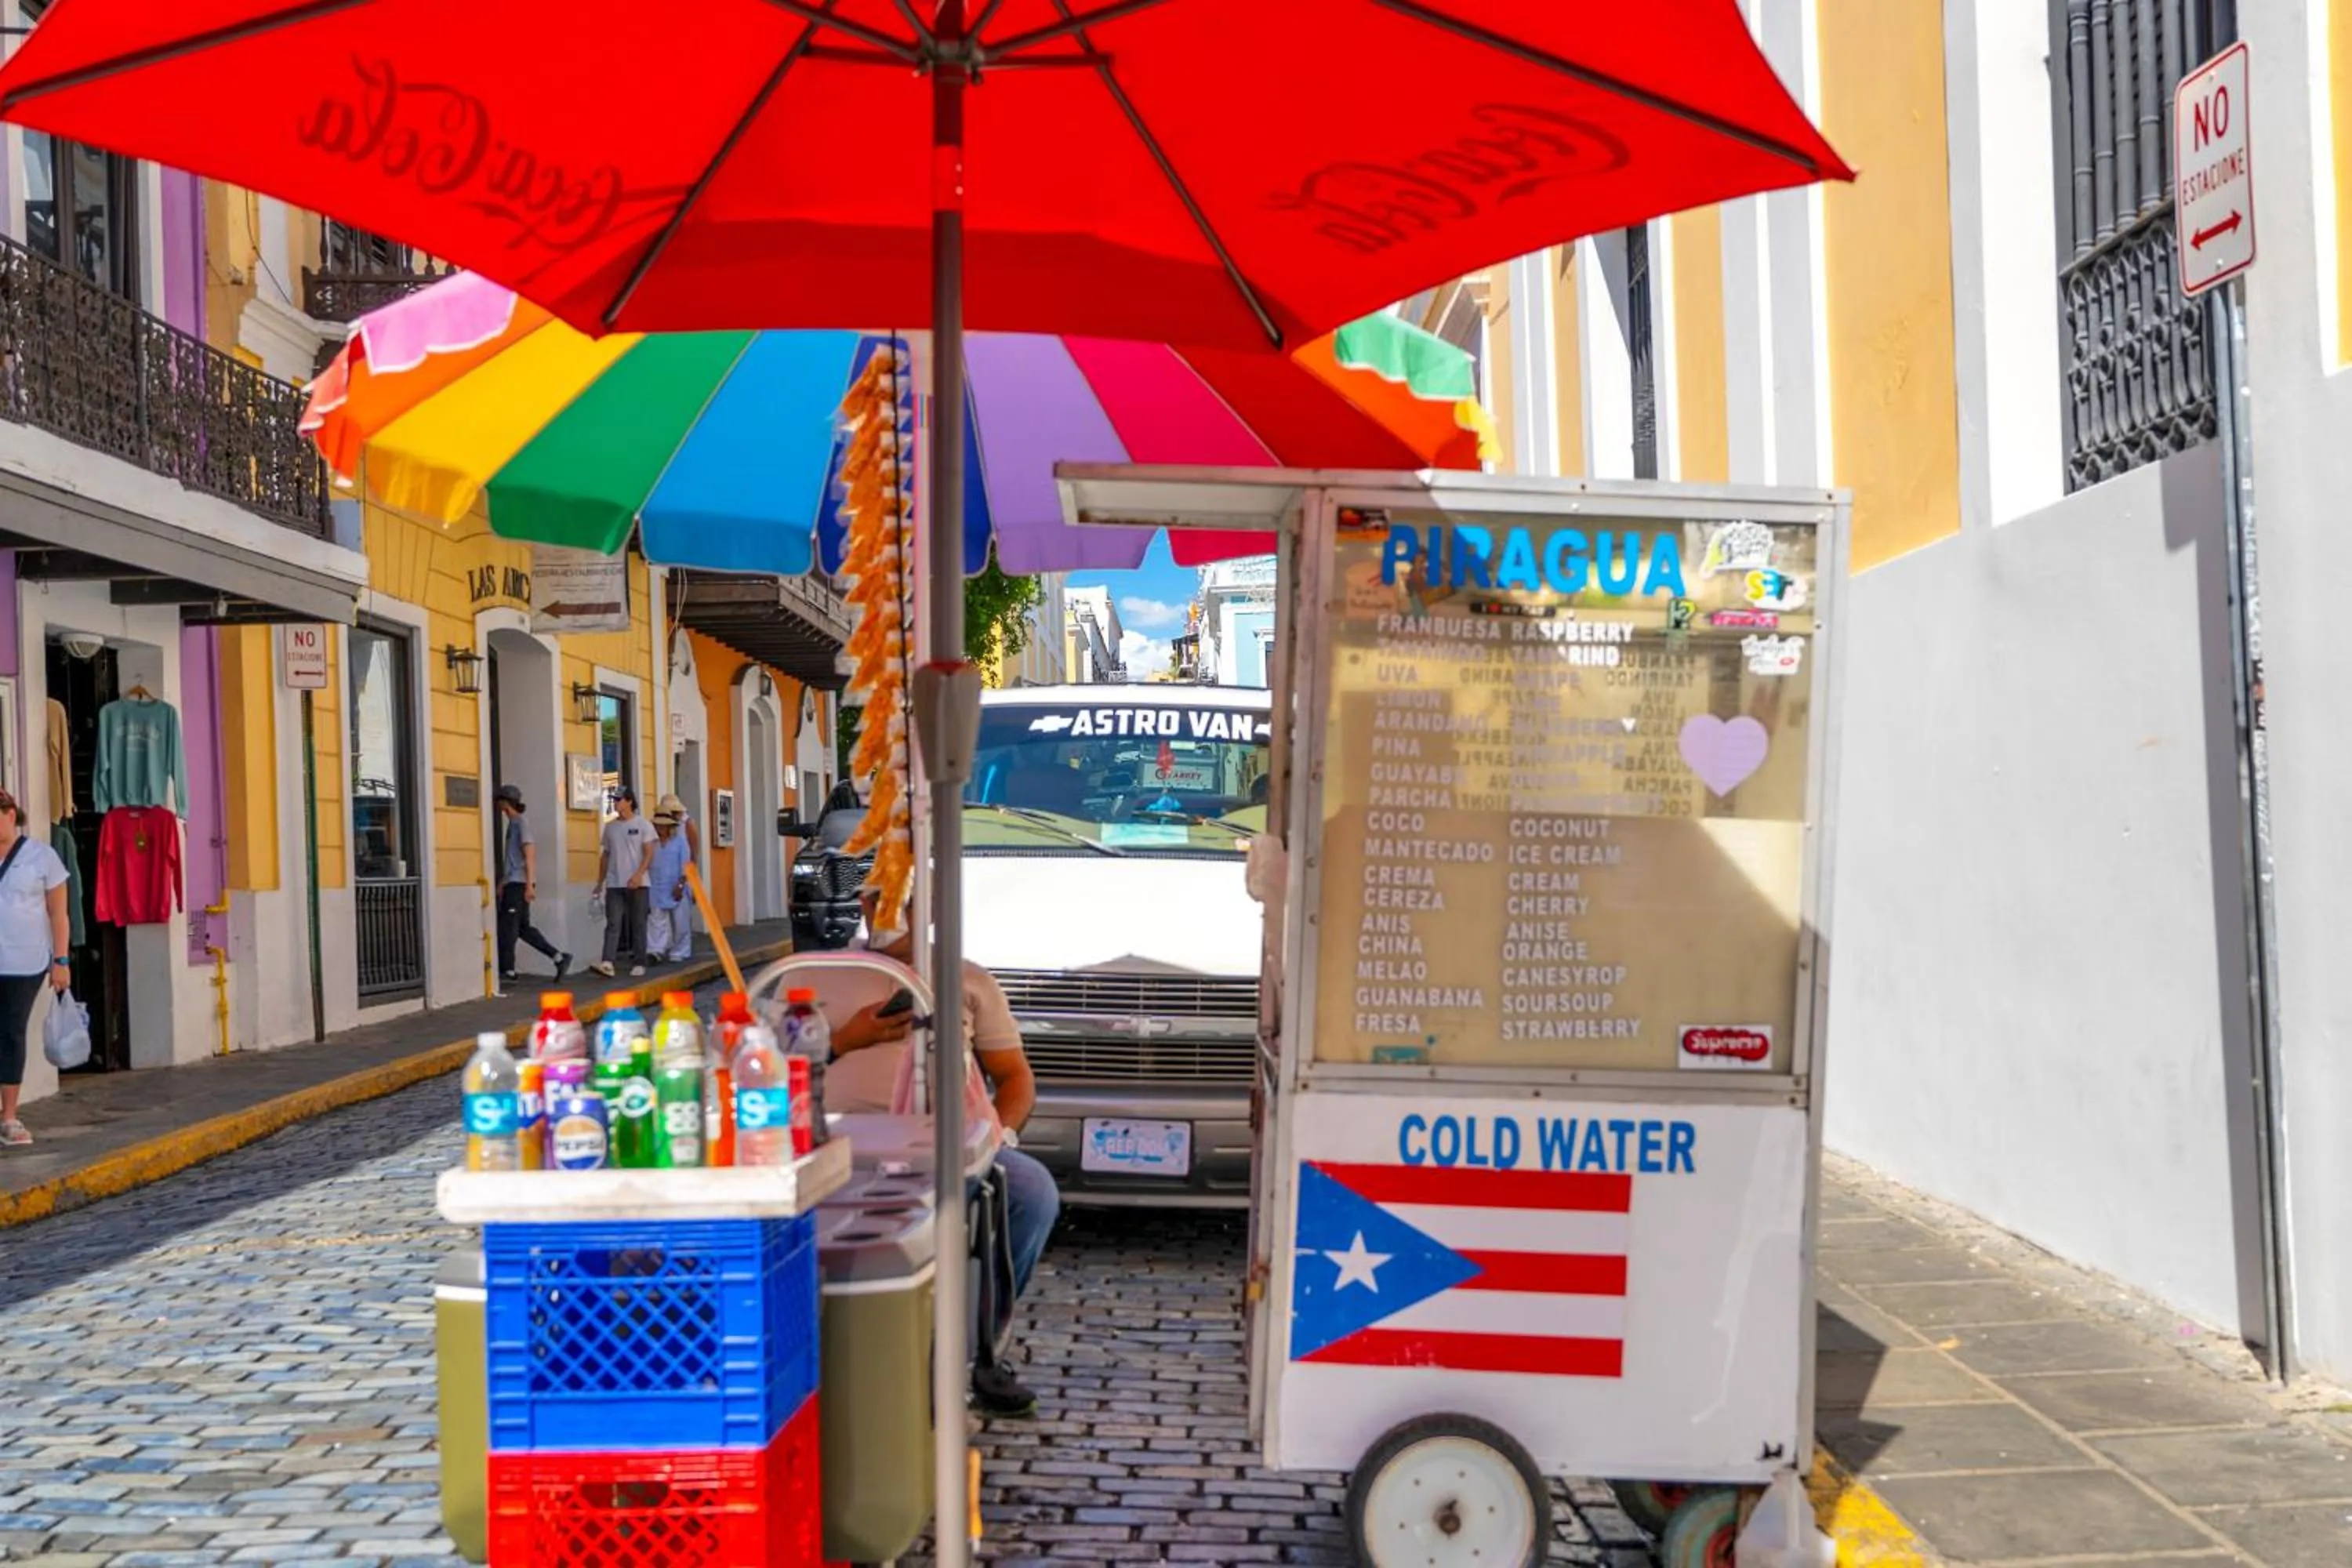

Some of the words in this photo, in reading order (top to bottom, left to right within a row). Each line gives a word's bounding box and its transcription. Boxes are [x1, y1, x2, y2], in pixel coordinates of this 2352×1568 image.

[2194, 85, 2229, 152] NO
[2183, 148, 2245, 205] ESTACIONE
[1381, 524, 1686, 597] PIRAGUA
[468, 564, 496, 602] LAS
[1377, 614, 1501, 640] FRANBUESA
[1512, 621, 1634, 643] RASPBERRY
[295, 631, 315, 648] NO
[1377, 663, 1417, 682] UVA
[1071, 709, 1180, 736] ASTRO
[1189, 711, 1252, 740] VAN
[1369, 786, 1451, 808] PARCHA
[1367, 812, 1425, 833] COCO
[1510, 818, 1611, 838] COCONUT
[1365, 839, 1494, 862] MANTECADO
[1508, 846, 1541, 864] ICE
[1549, 845, 1621, 865] CREAM
[1364, 866, 1435, 886] CREMA
[1508, 873, 1580, 892] CREAM
[1364, 888, 1444, 909] CEREZA
[1507, 897, 1589, 916] CHERRY
[1362, 913, 1410, 934] ANIS
[1507, 922, 1569, 941] ANISE
[1359, 936, 1422, 955] CHINA
[1503, 942, 1588, 961] ORANGE
[1356, 987, 1484, 1008] GUANABANA
[1502, 993, 1614, 1014] SOURSOUP
[1356, 1013, 1421, 1034] FRESA
[1501, 1019, 1640, 1040] STRAWBERRY
[1399, 1113, 1521, 1168] COLD
[1537, 1118, 1696, 1174] WATER
